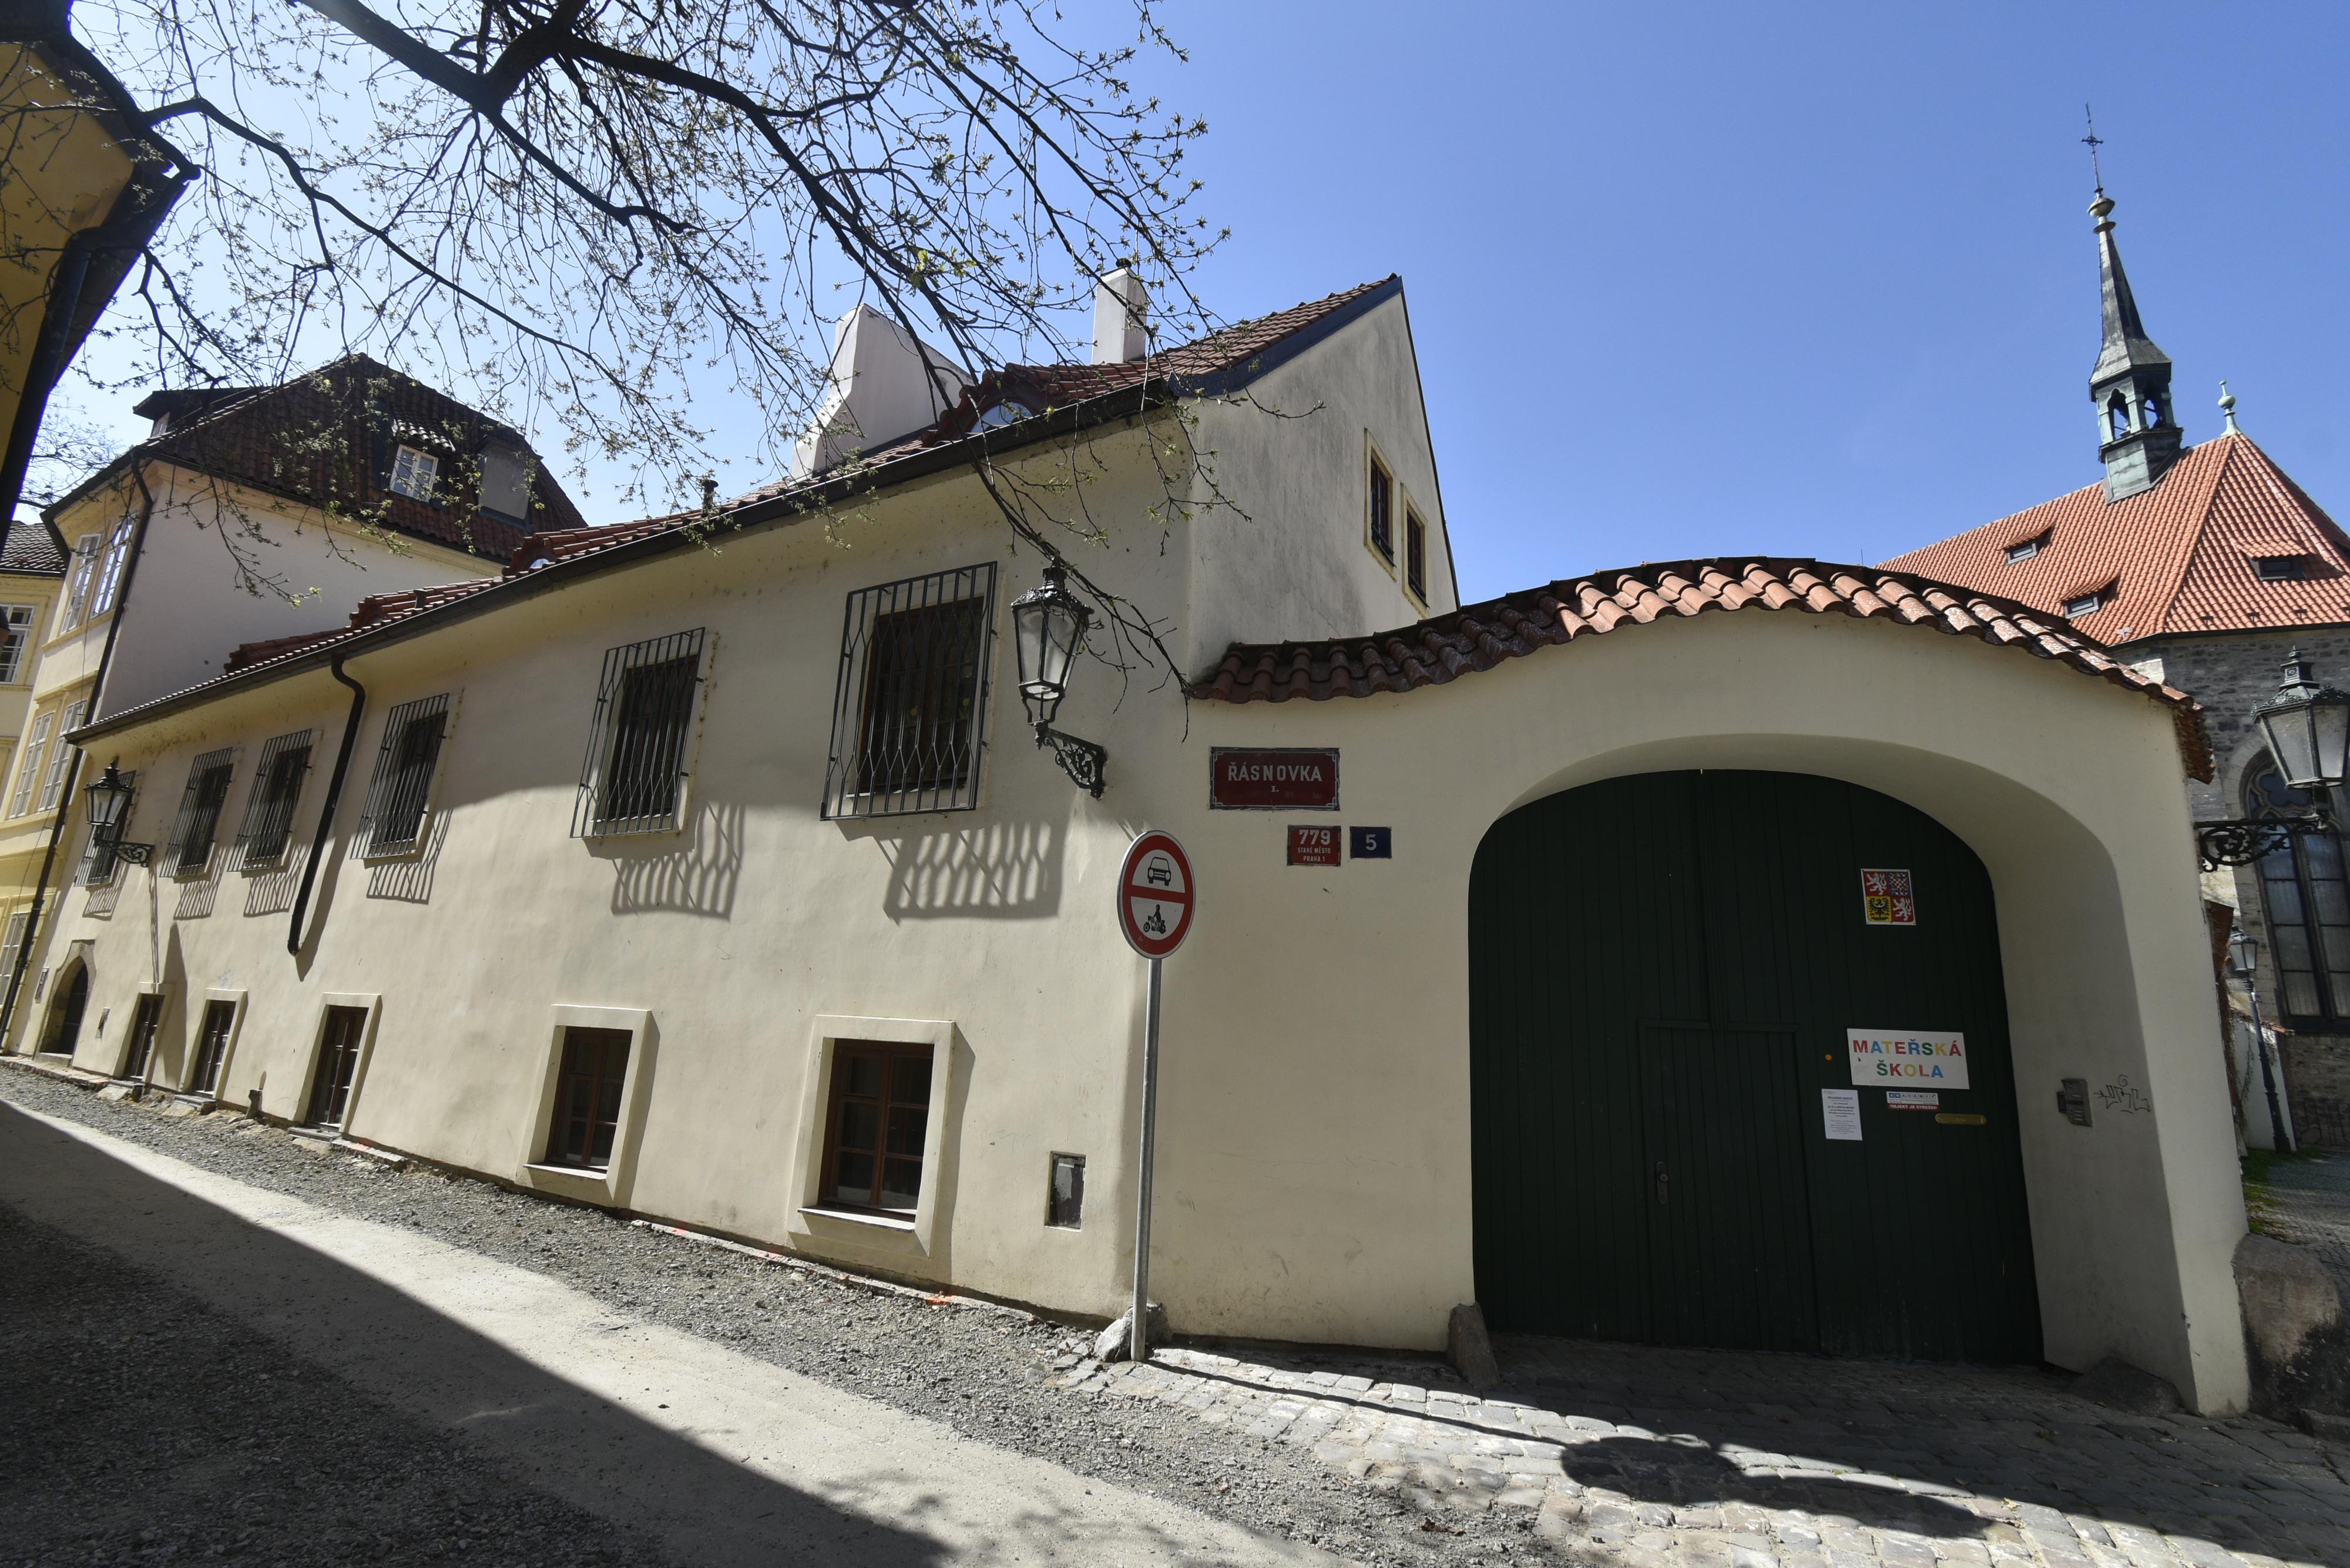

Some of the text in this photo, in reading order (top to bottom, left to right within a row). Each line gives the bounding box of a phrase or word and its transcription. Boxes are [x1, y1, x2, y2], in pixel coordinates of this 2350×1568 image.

[1228, 762, 1322, 781] ŘÁSNOVKA
[1299, 830, 1331, 845] 779
[1365, 834, 1377, 851] 5
[1853, 1039, 1962, 1056] MATEŘSKÁ
[1877, 1060, 1943, 1078] ŠKOLA
